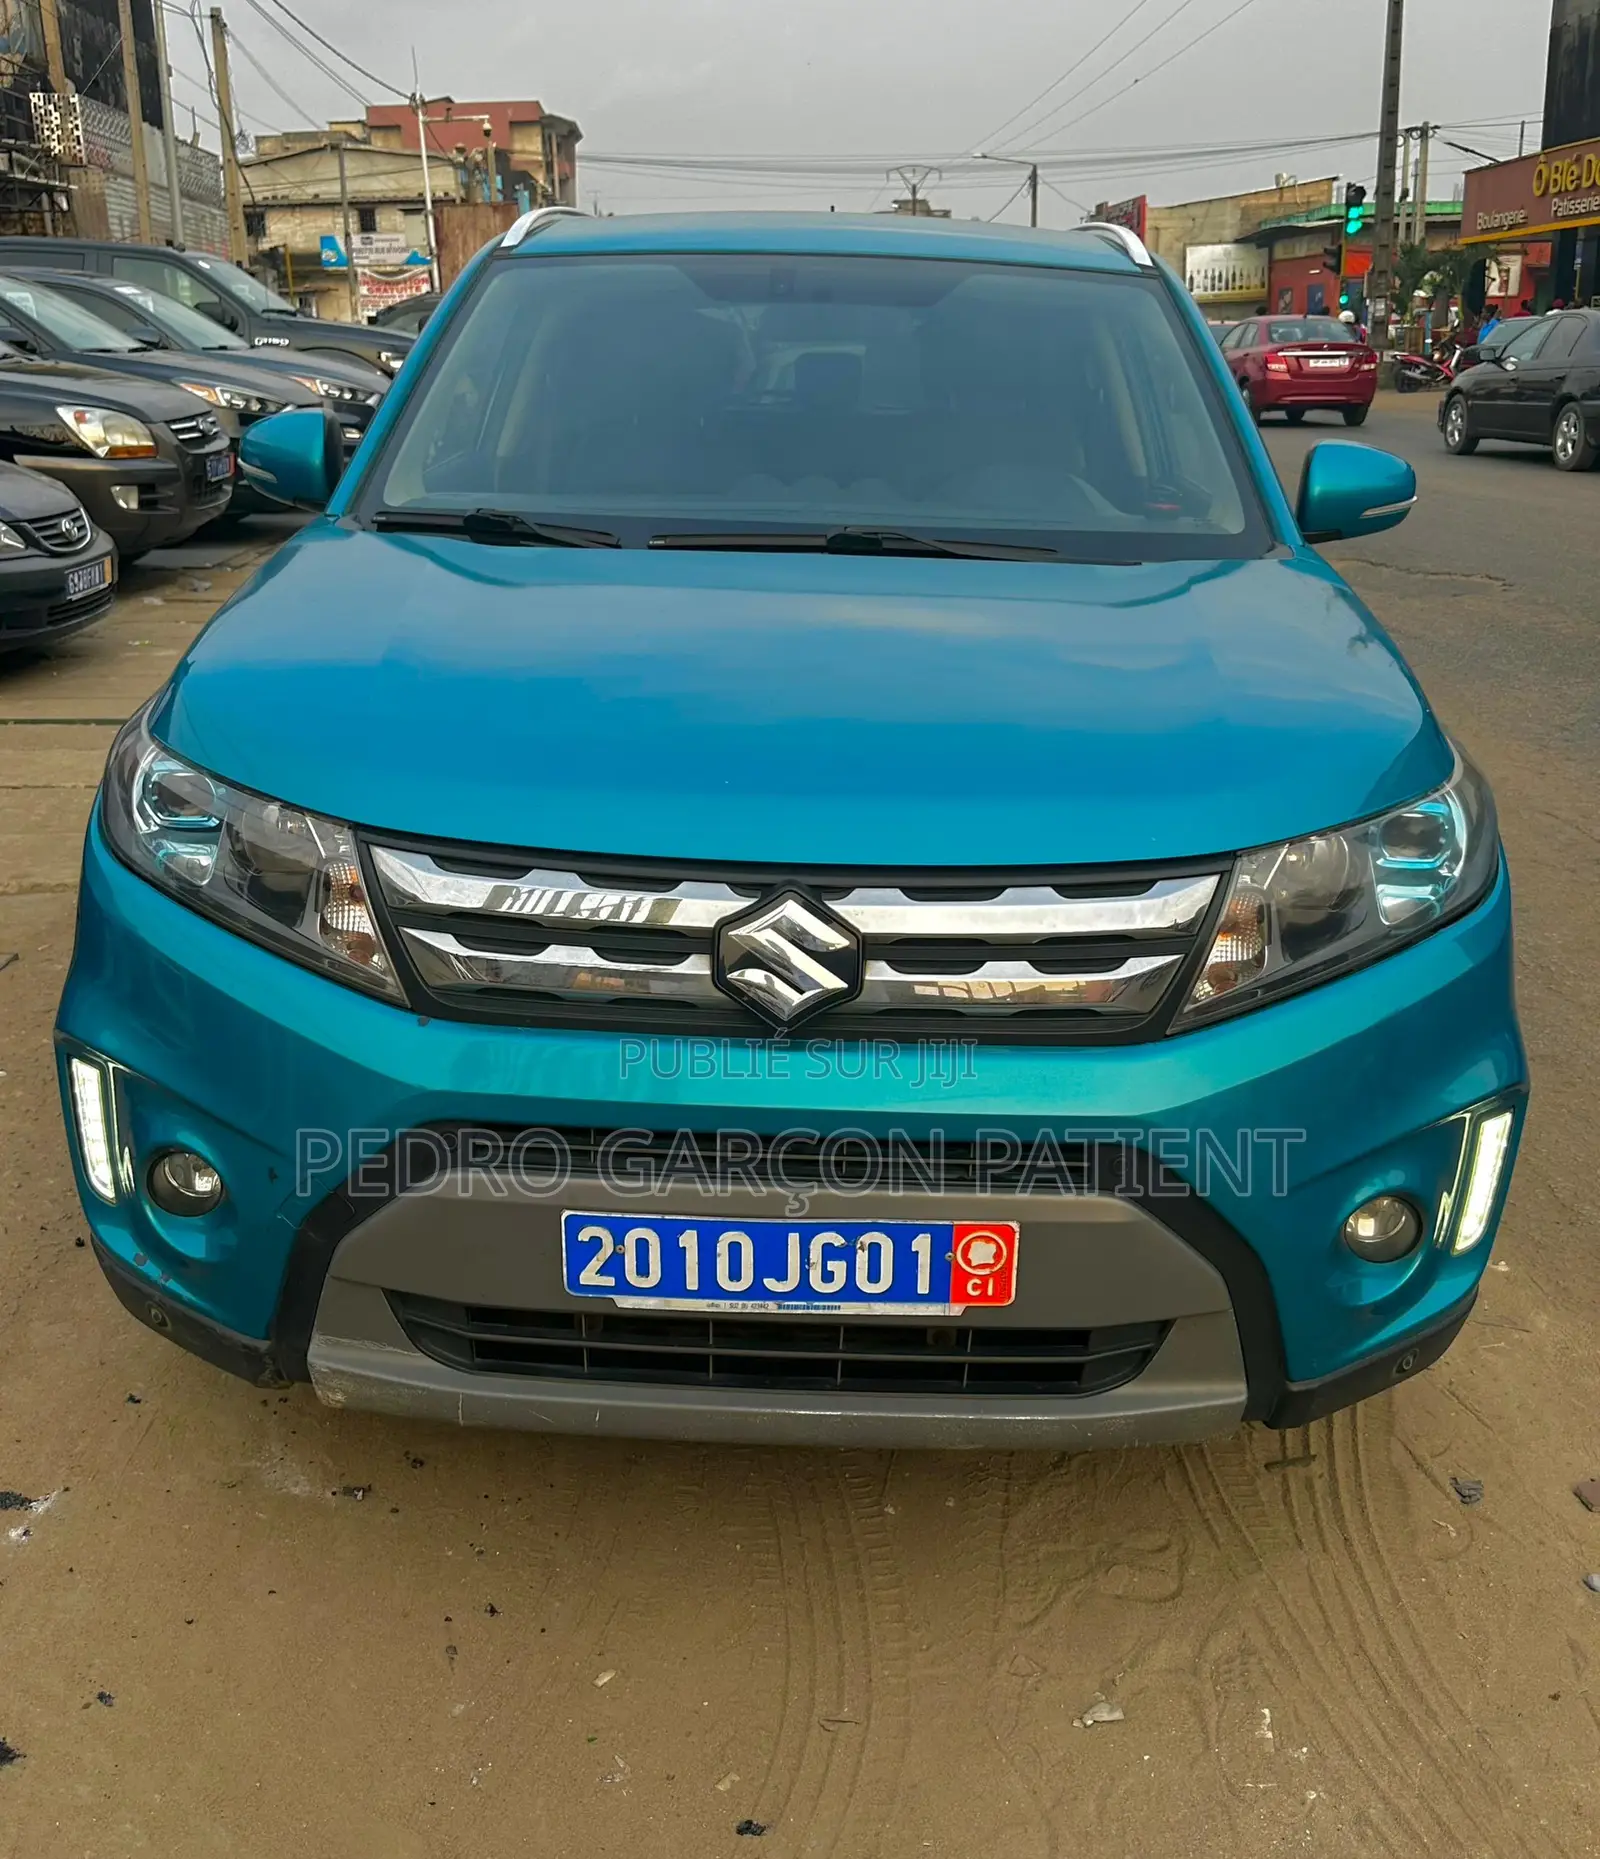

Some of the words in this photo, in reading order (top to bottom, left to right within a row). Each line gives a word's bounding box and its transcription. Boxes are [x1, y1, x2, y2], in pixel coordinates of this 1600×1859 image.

[1549, 152, 1580, 195] Blé
[577, 1225, 932, 1295] 2010JG01
[966, 1278, 995, 1297] CI
